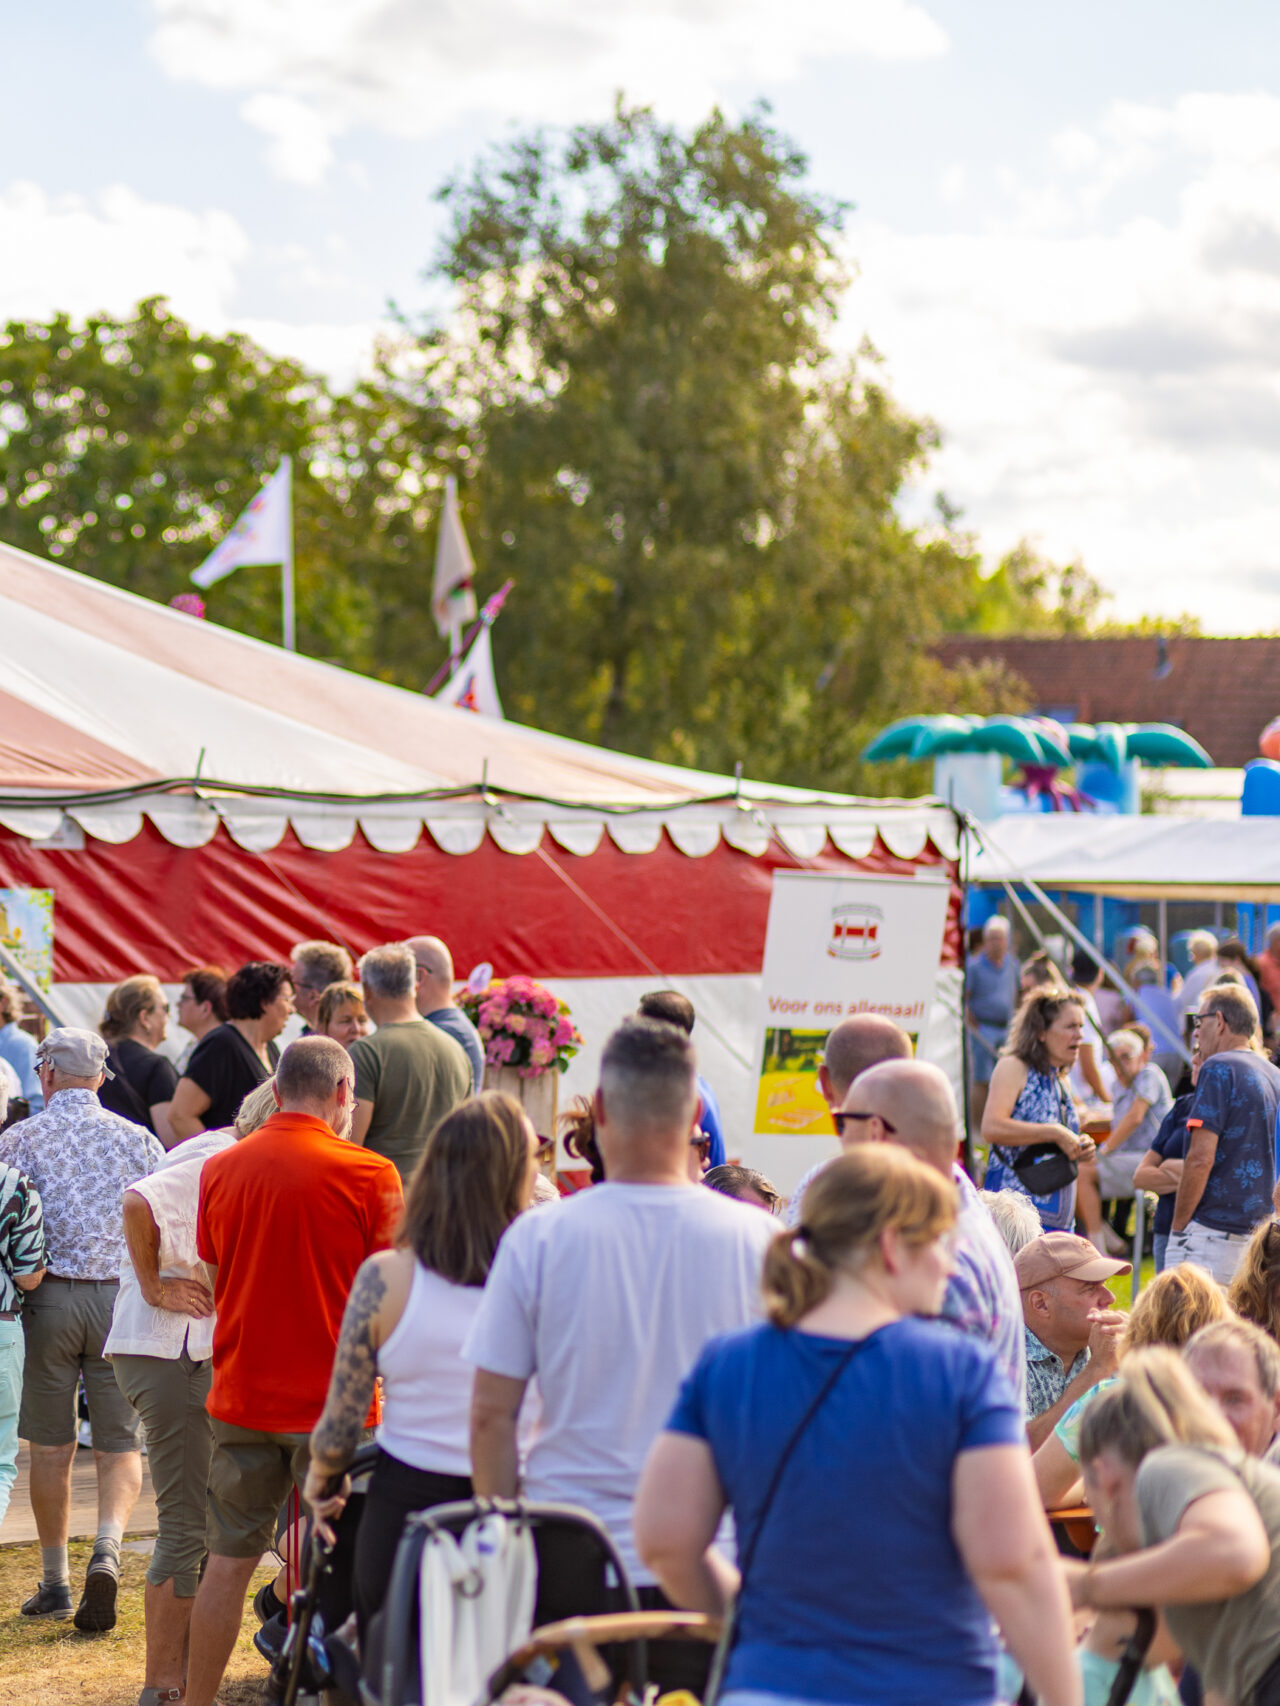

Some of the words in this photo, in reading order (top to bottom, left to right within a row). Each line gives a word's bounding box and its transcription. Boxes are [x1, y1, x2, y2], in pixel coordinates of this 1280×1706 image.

[769, 997, 808, 1014] Voor
[814, 1001, 842, 1016] ons
[848, 1000, 924, 1017] allemaal!
